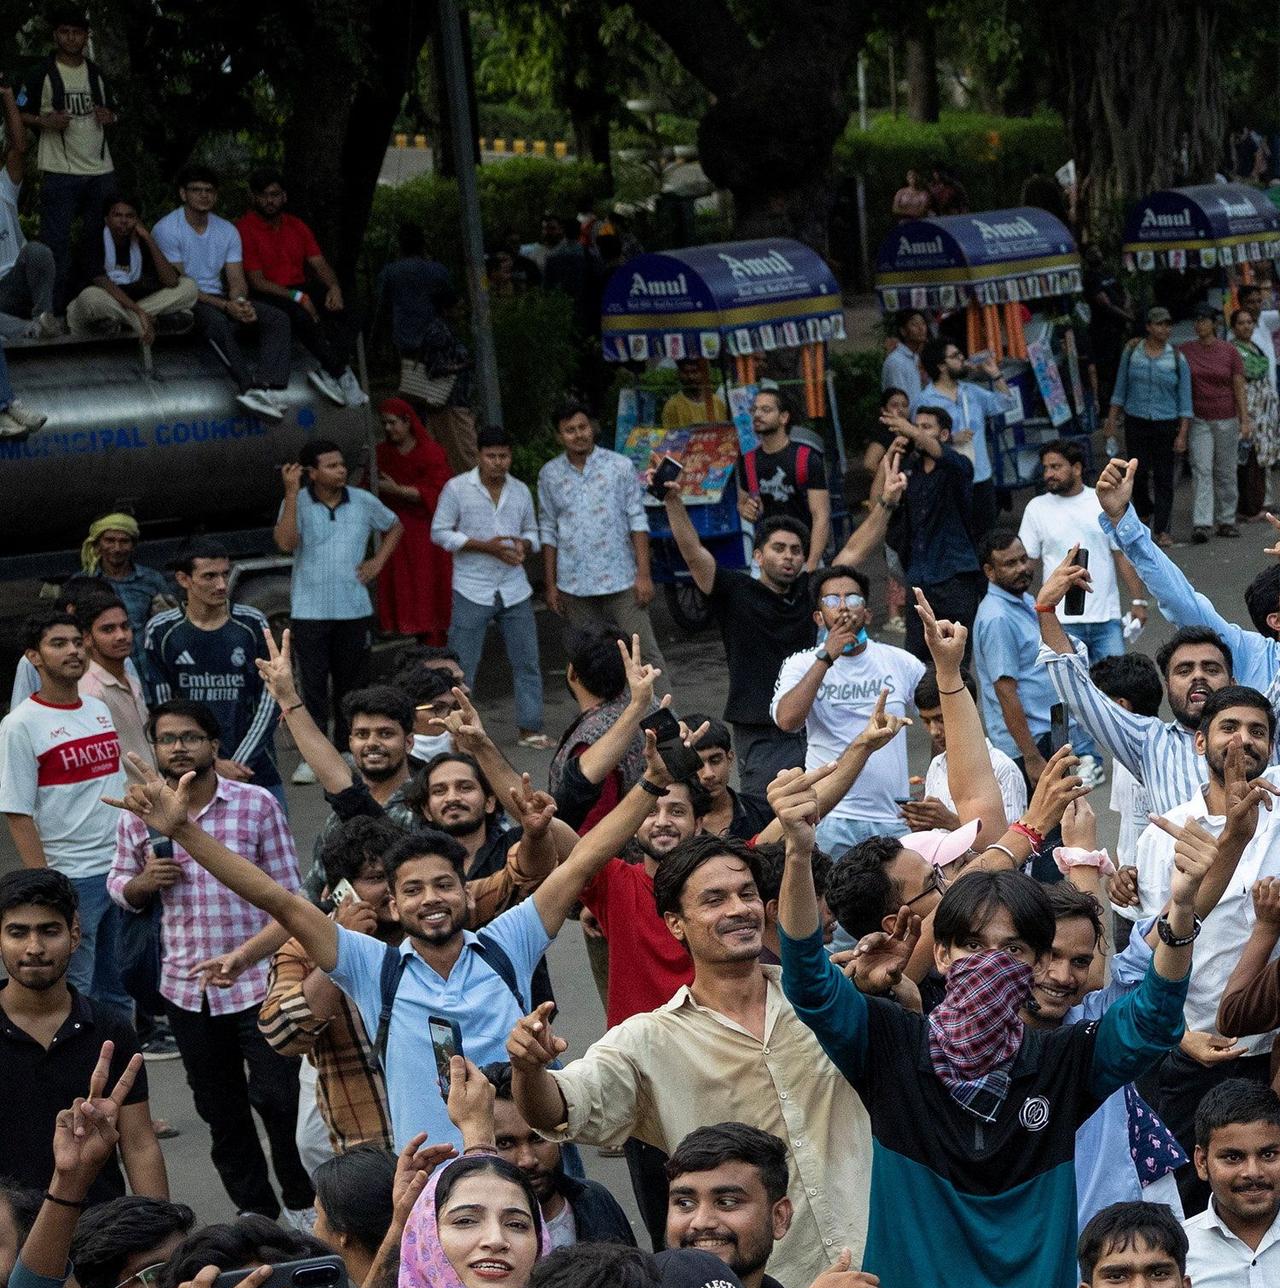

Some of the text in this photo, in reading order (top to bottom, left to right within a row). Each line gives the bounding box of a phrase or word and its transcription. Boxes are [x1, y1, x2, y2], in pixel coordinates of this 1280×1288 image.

[972, 216, 1039, 240] Amul
[1141, 208, 1191, 227] Amul
[897, 235, 943, 256] Amul
[718, 249, 794, 279] Amul
[629, 272, 689, 296] Amul
[179, 672, 245, 689] Emirates
[189, 687, 239, 700] FLY BETTER
